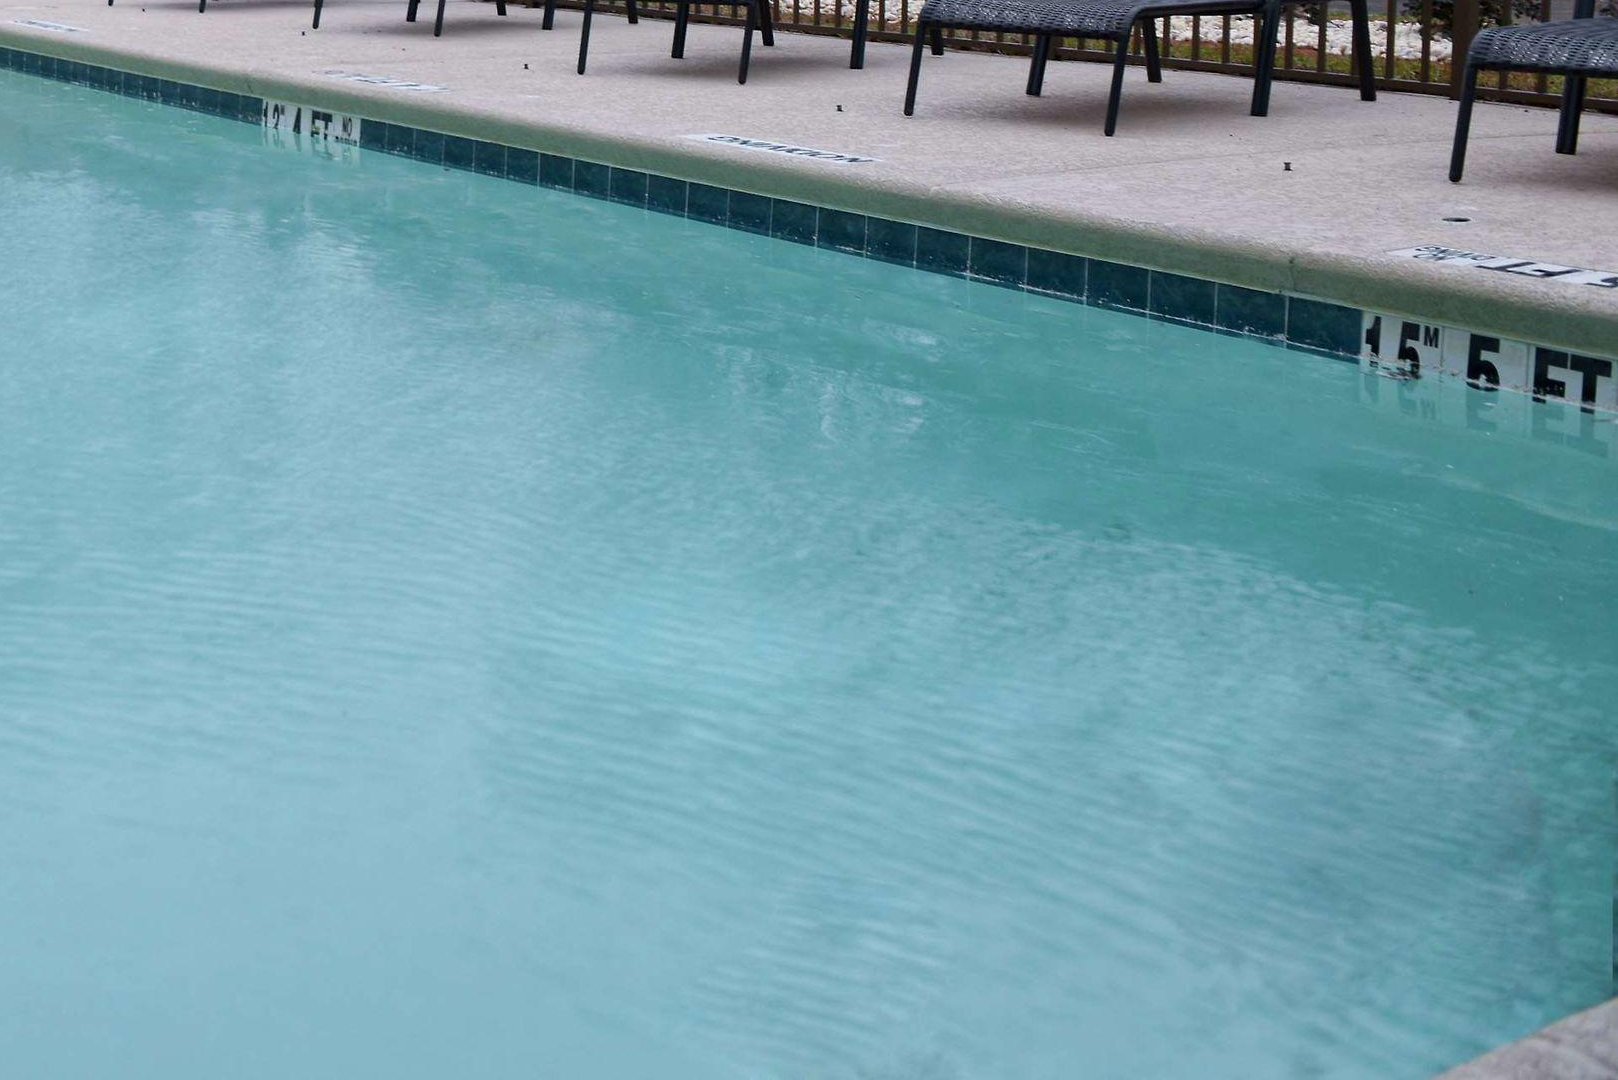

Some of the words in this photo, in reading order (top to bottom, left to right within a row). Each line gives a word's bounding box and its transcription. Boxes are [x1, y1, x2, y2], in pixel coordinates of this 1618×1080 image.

[310, 110, 333, 140] FT
[1466, 332, 1501, 392] 5
[1533, 346, 1613, 414] FT
